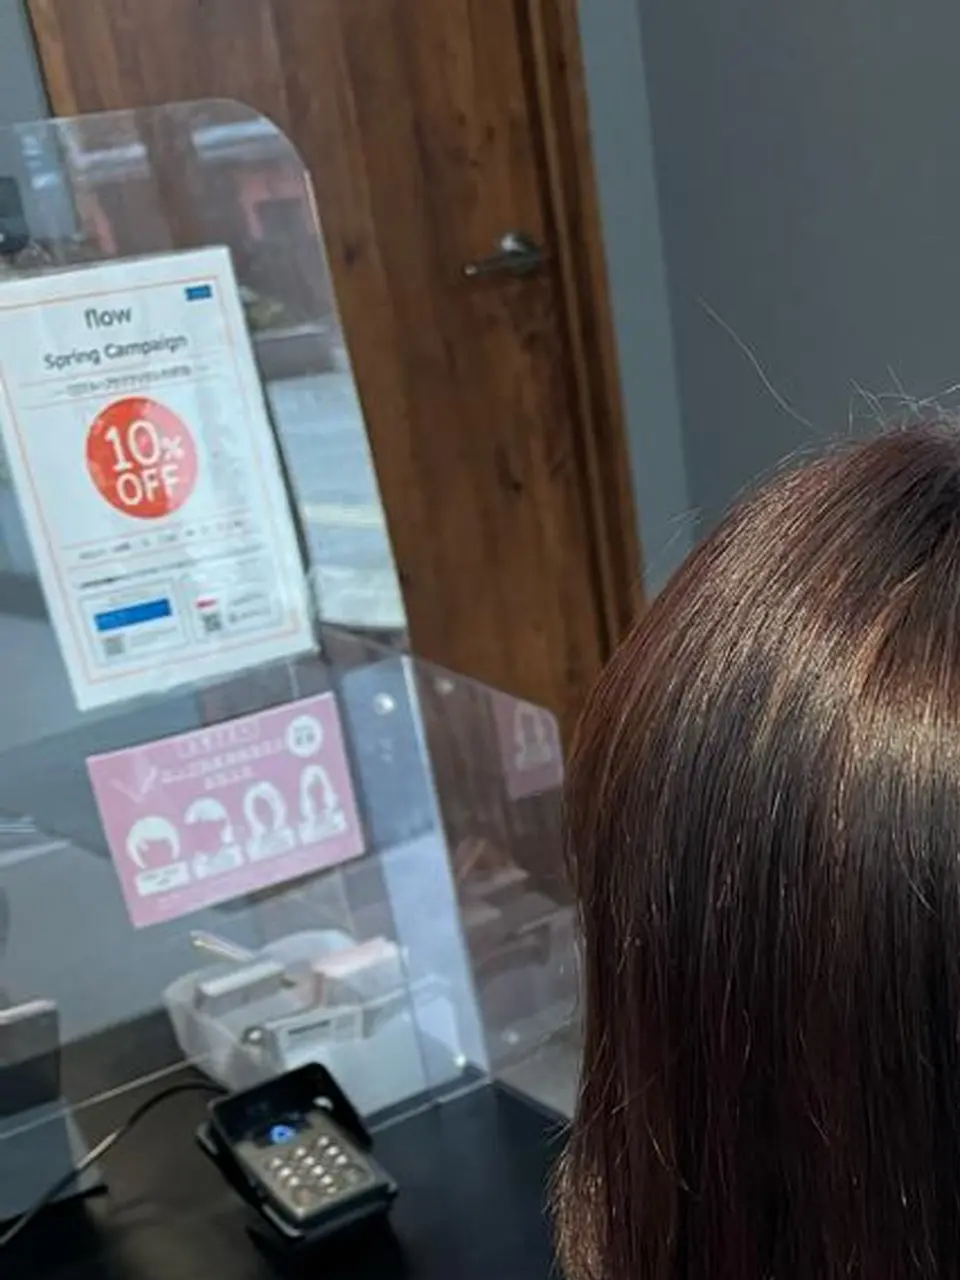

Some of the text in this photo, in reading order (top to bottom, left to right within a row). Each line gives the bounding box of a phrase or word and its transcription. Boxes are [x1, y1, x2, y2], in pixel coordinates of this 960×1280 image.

[44, 333, 188, 371] Spring Campaign
[116, 465, 179, 506] OFF
